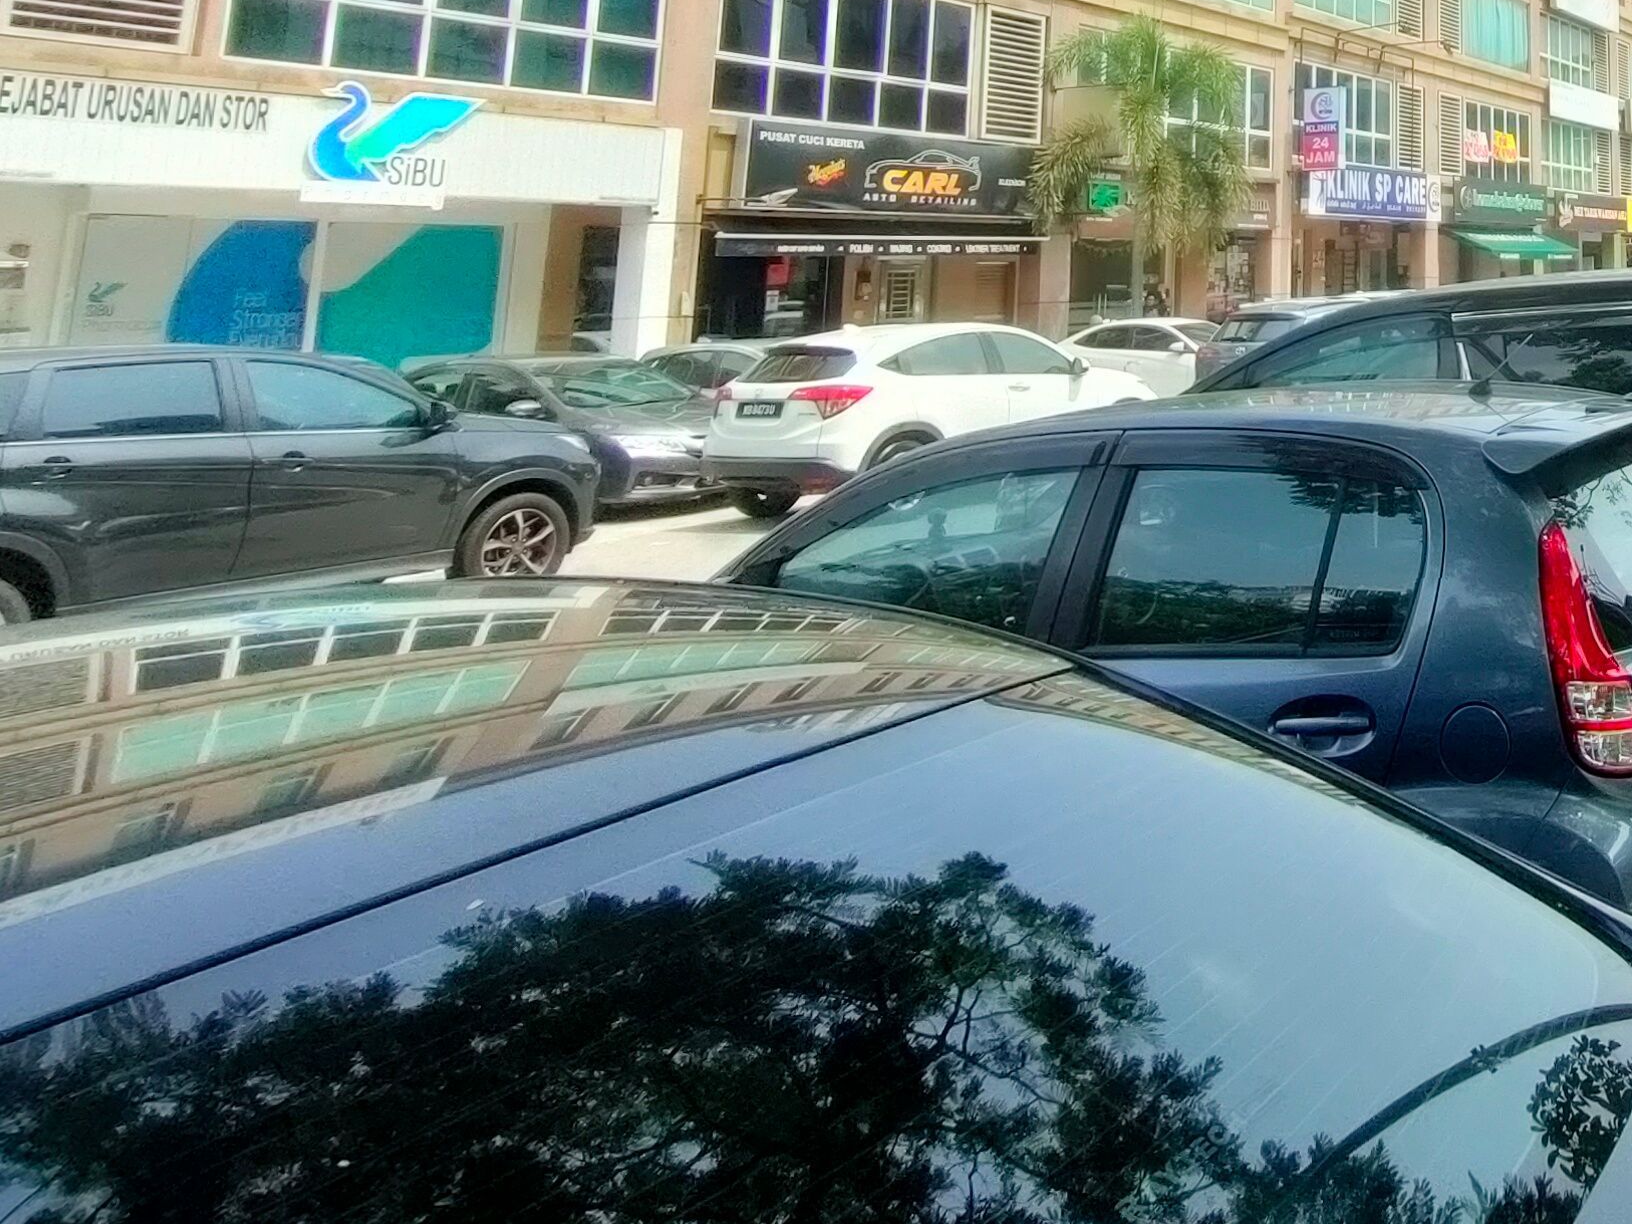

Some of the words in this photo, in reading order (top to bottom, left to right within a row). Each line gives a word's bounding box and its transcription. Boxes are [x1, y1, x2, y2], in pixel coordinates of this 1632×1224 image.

[87, 83, 173, 124] URUSAN
[175, 90, 217, 127] DAN
[219, 94, 269, 131] STOR
[1305, 123, 1337, 133] KLINIK
[760, 130, 796, 143] PUSAT
[798, 133, 824, 146] CUCI
[826, 136, 865, 149] KERETA
[1312, 137, 1329, 149] 24
[1306, 151, 1335, 164] JAM
[882, 169, 962, 195] CARL
[1326, 169, 1371, 201] KLINIK
[1375, 172, 1392, 202] SP
[1395, 175, 1426, 205] CARE
